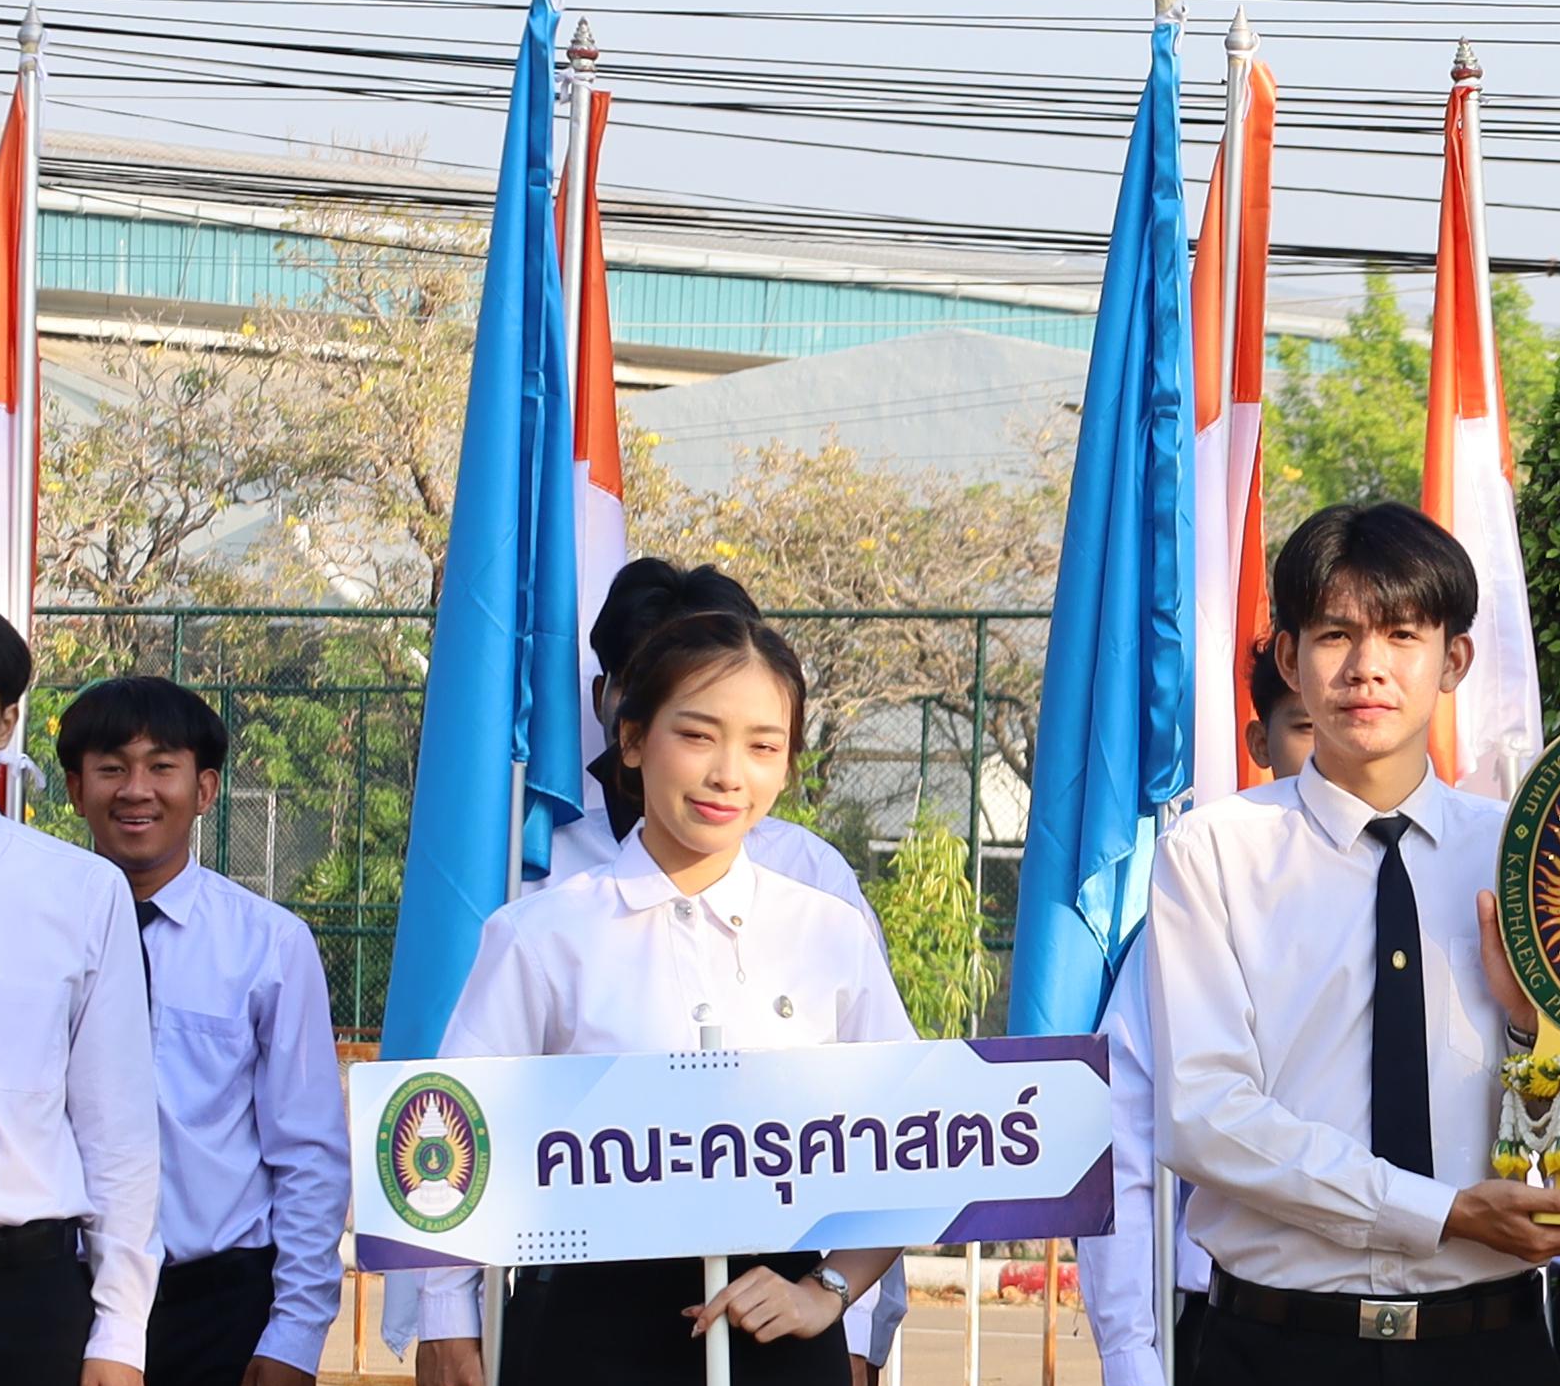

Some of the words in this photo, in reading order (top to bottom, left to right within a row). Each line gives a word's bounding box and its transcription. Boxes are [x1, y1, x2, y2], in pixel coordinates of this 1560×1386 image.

[1506, 851, 1548, 991] KAMPHAENG
[535, 1086, 1041, 1205] คณะครุศาสตร์
